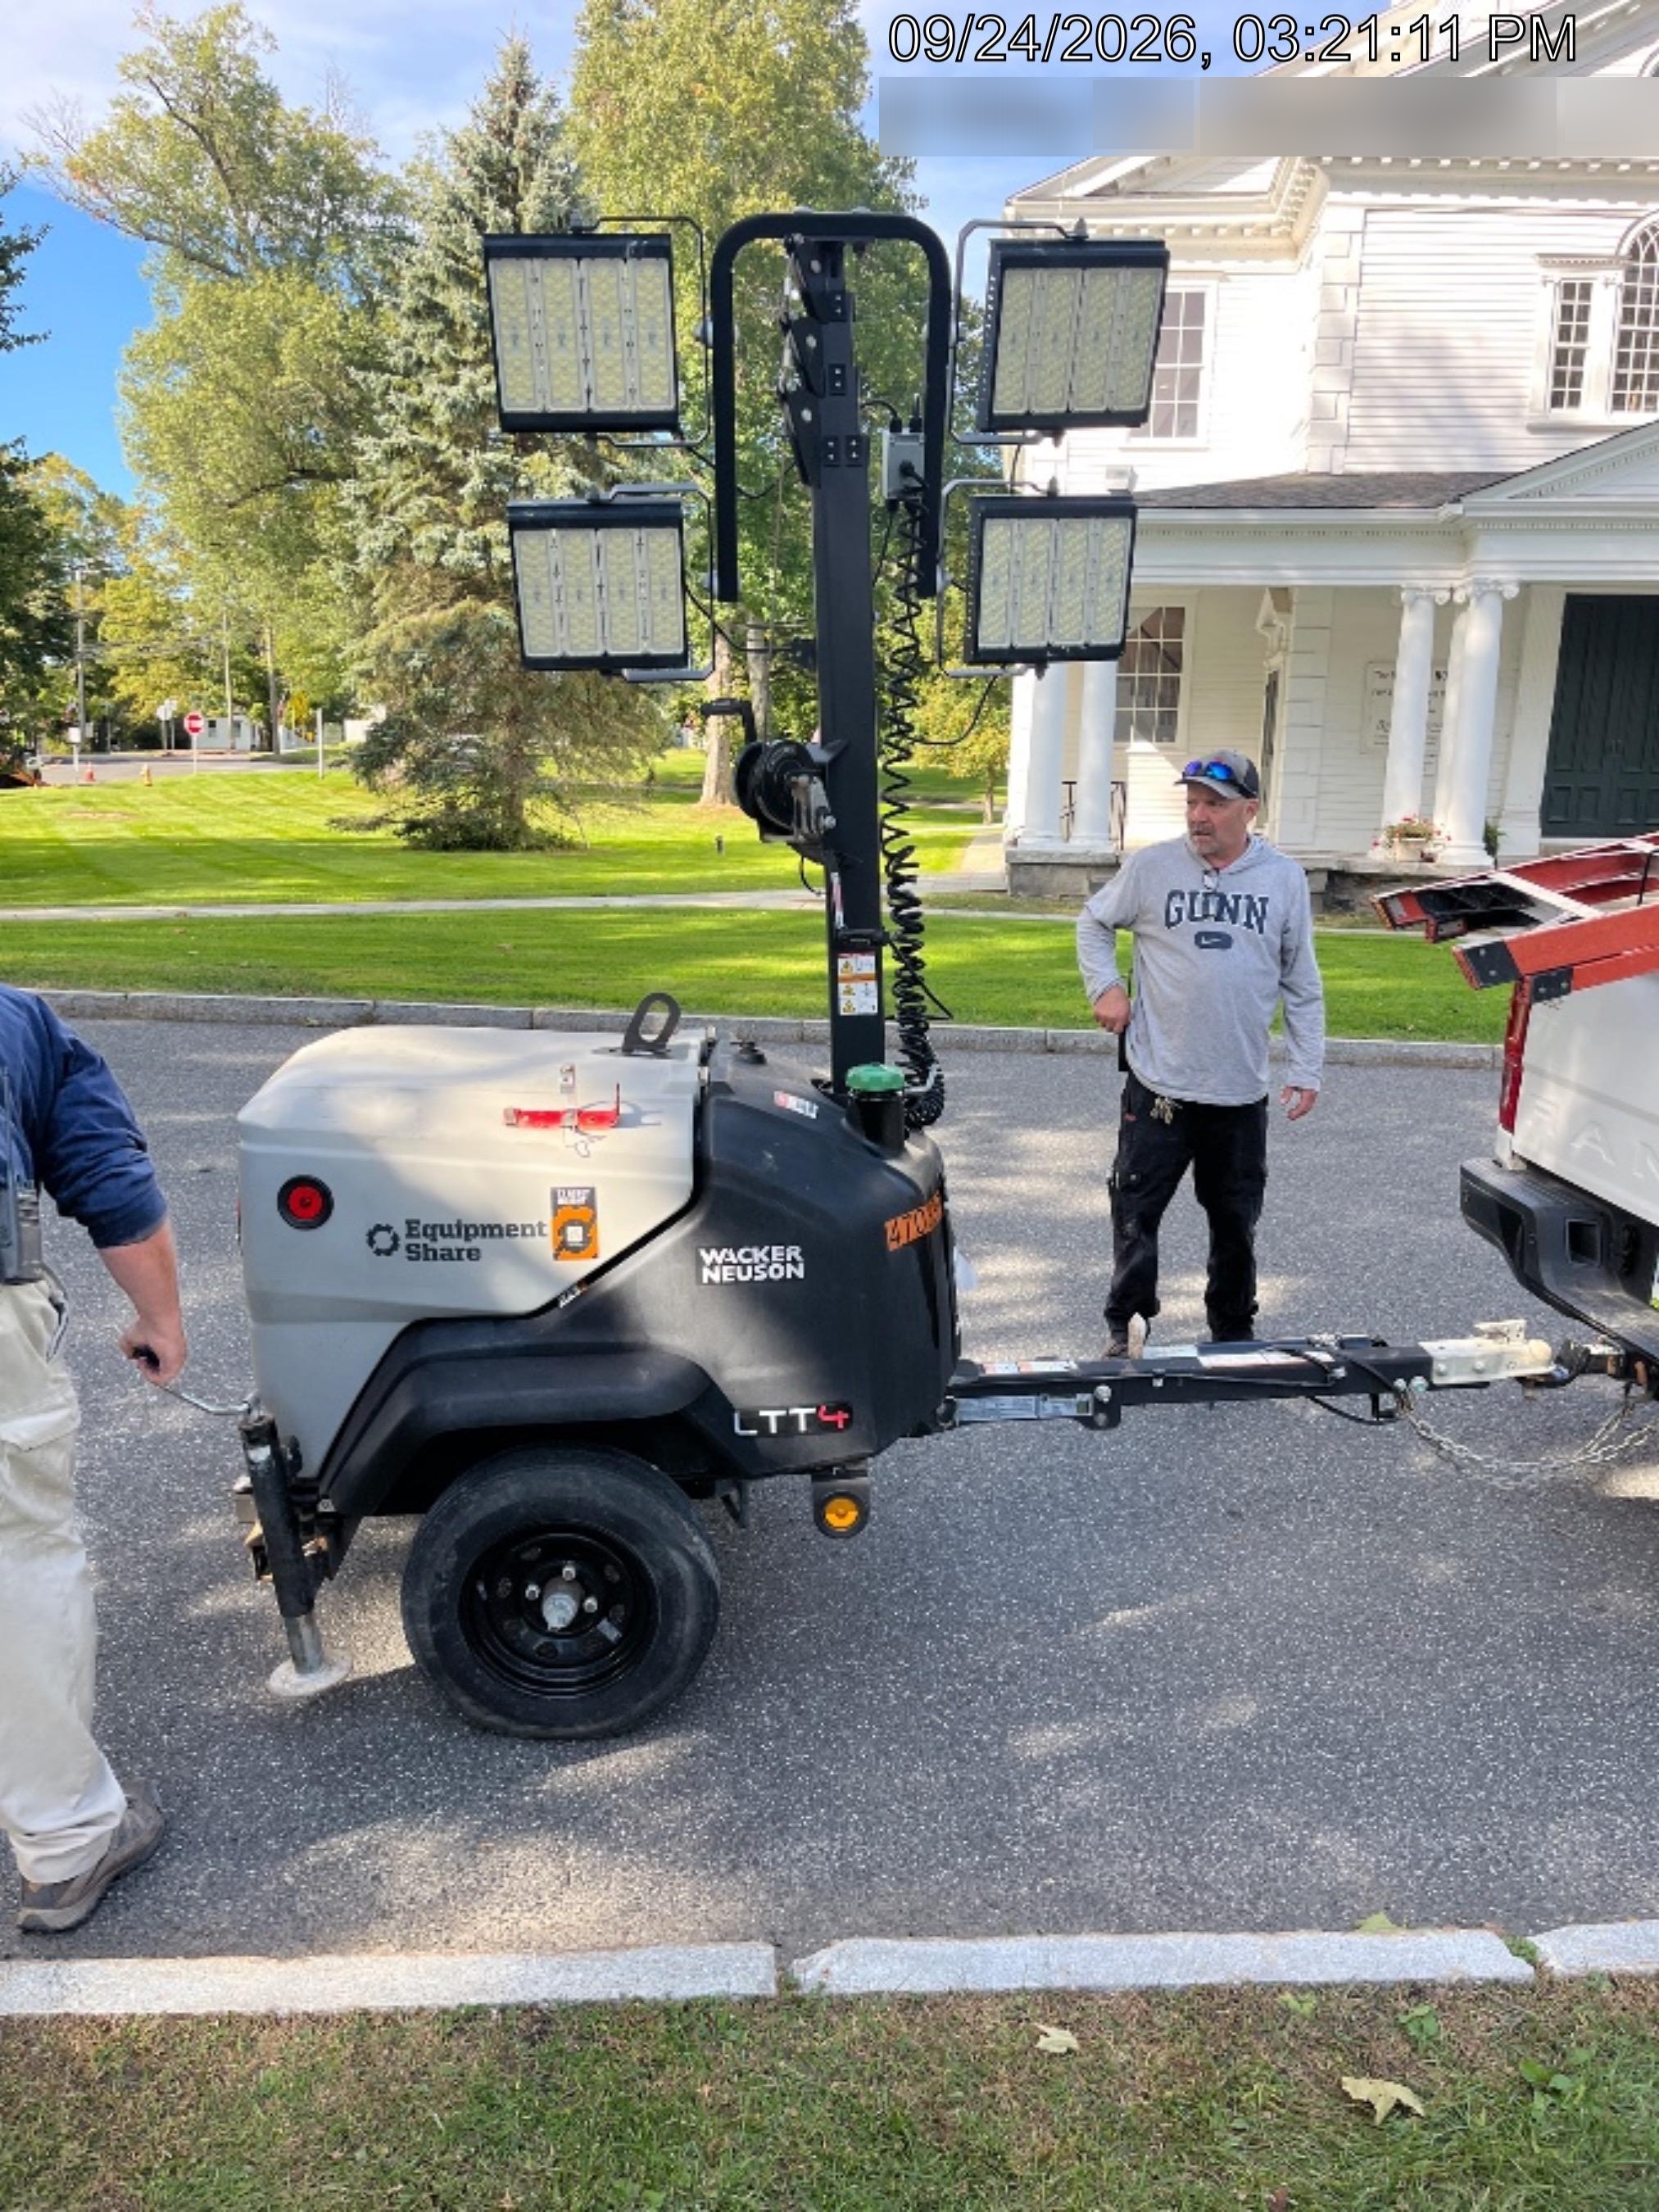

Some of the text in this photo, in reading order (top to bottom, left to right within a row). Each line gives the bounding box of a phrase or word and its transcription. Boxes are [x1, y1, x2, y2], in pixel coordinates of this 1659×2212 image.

[1164, 889, 1269, 934] GUNN
[405, 1218, 547, 1243] Equipment
[405, 1243, 482, 1262] Share
[698, 1245, 804, 1265] WACKER
[702, 1262, 805, 1284] NEUSON
[734, 1405, 850, 1435] LTT4
